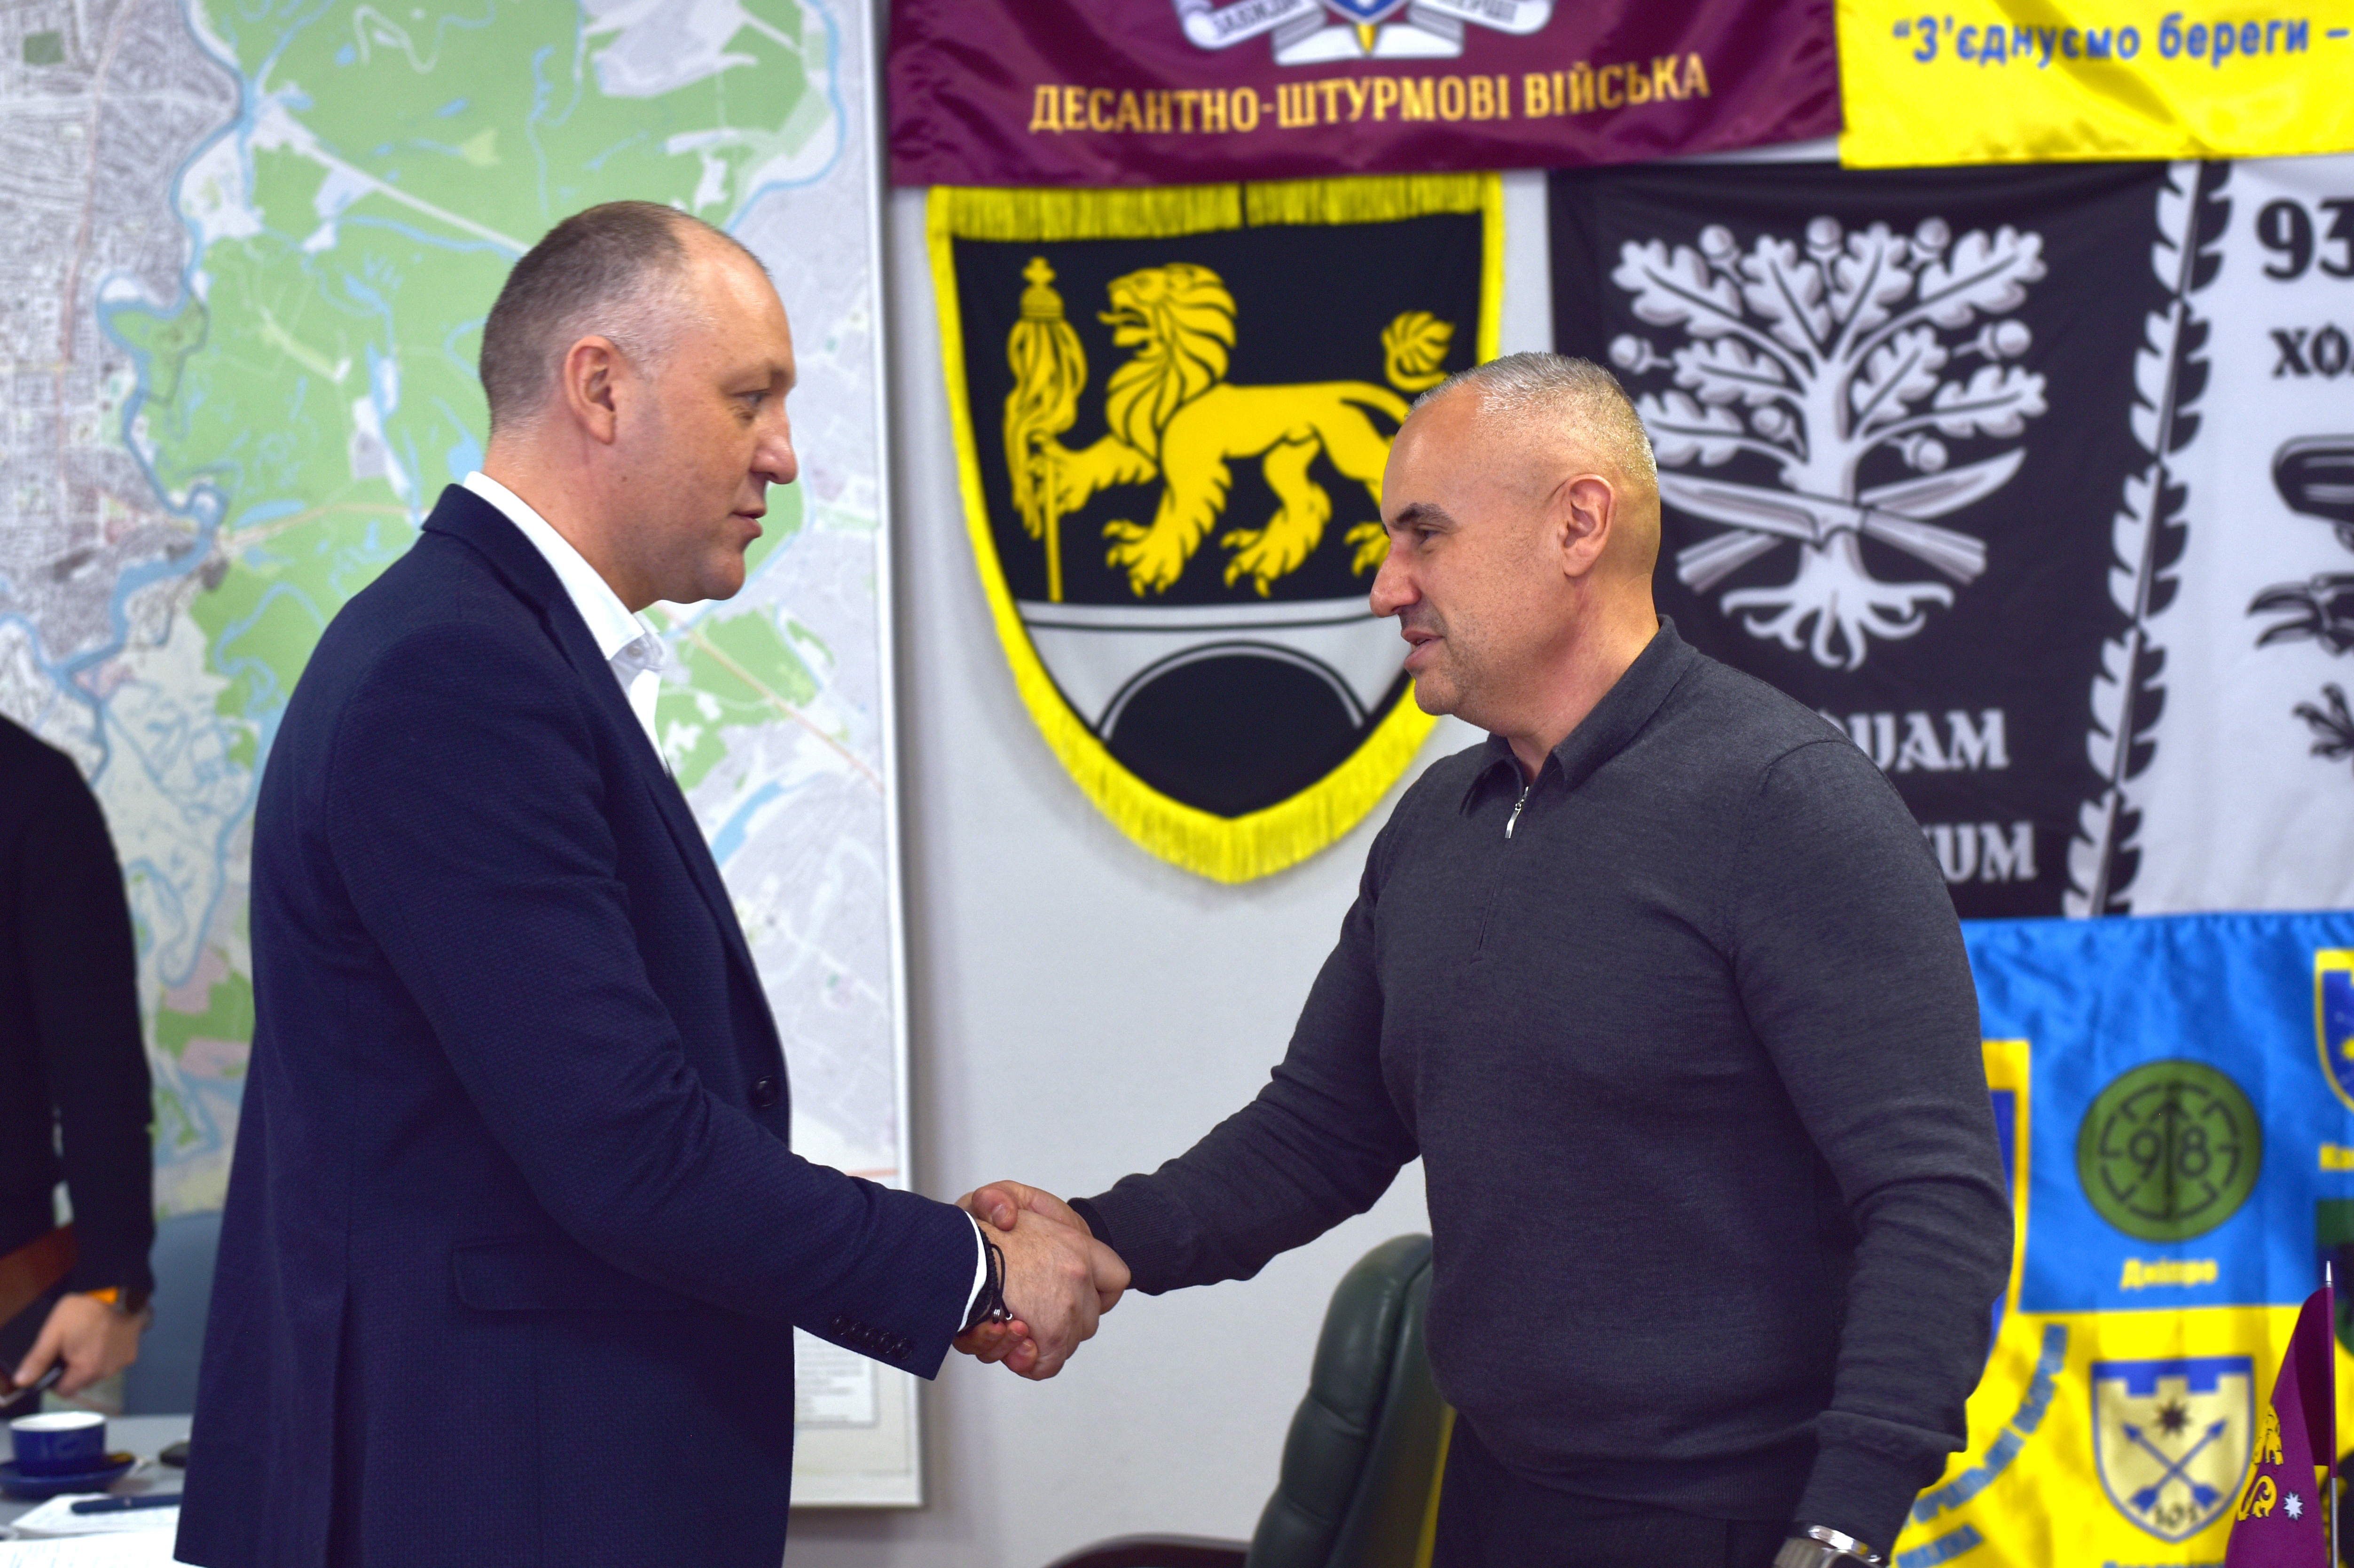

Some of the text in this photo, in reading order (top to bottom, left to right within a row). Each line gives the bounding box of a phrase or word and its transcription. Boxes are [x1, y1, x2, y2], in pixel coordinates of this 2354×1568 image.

[2158, 13, 2310, 69] береги
[1029, 54, 1710, 133] ДЕСАНТНО-ШТУРМОВІ ВІЙСЬКА
[2255, 196, 2354, 281] 93
[2269, 322, 2354, 380] ХО
[1819, 707, 2010, 772] UAM
[1922, 820, 2038, 884] UM
